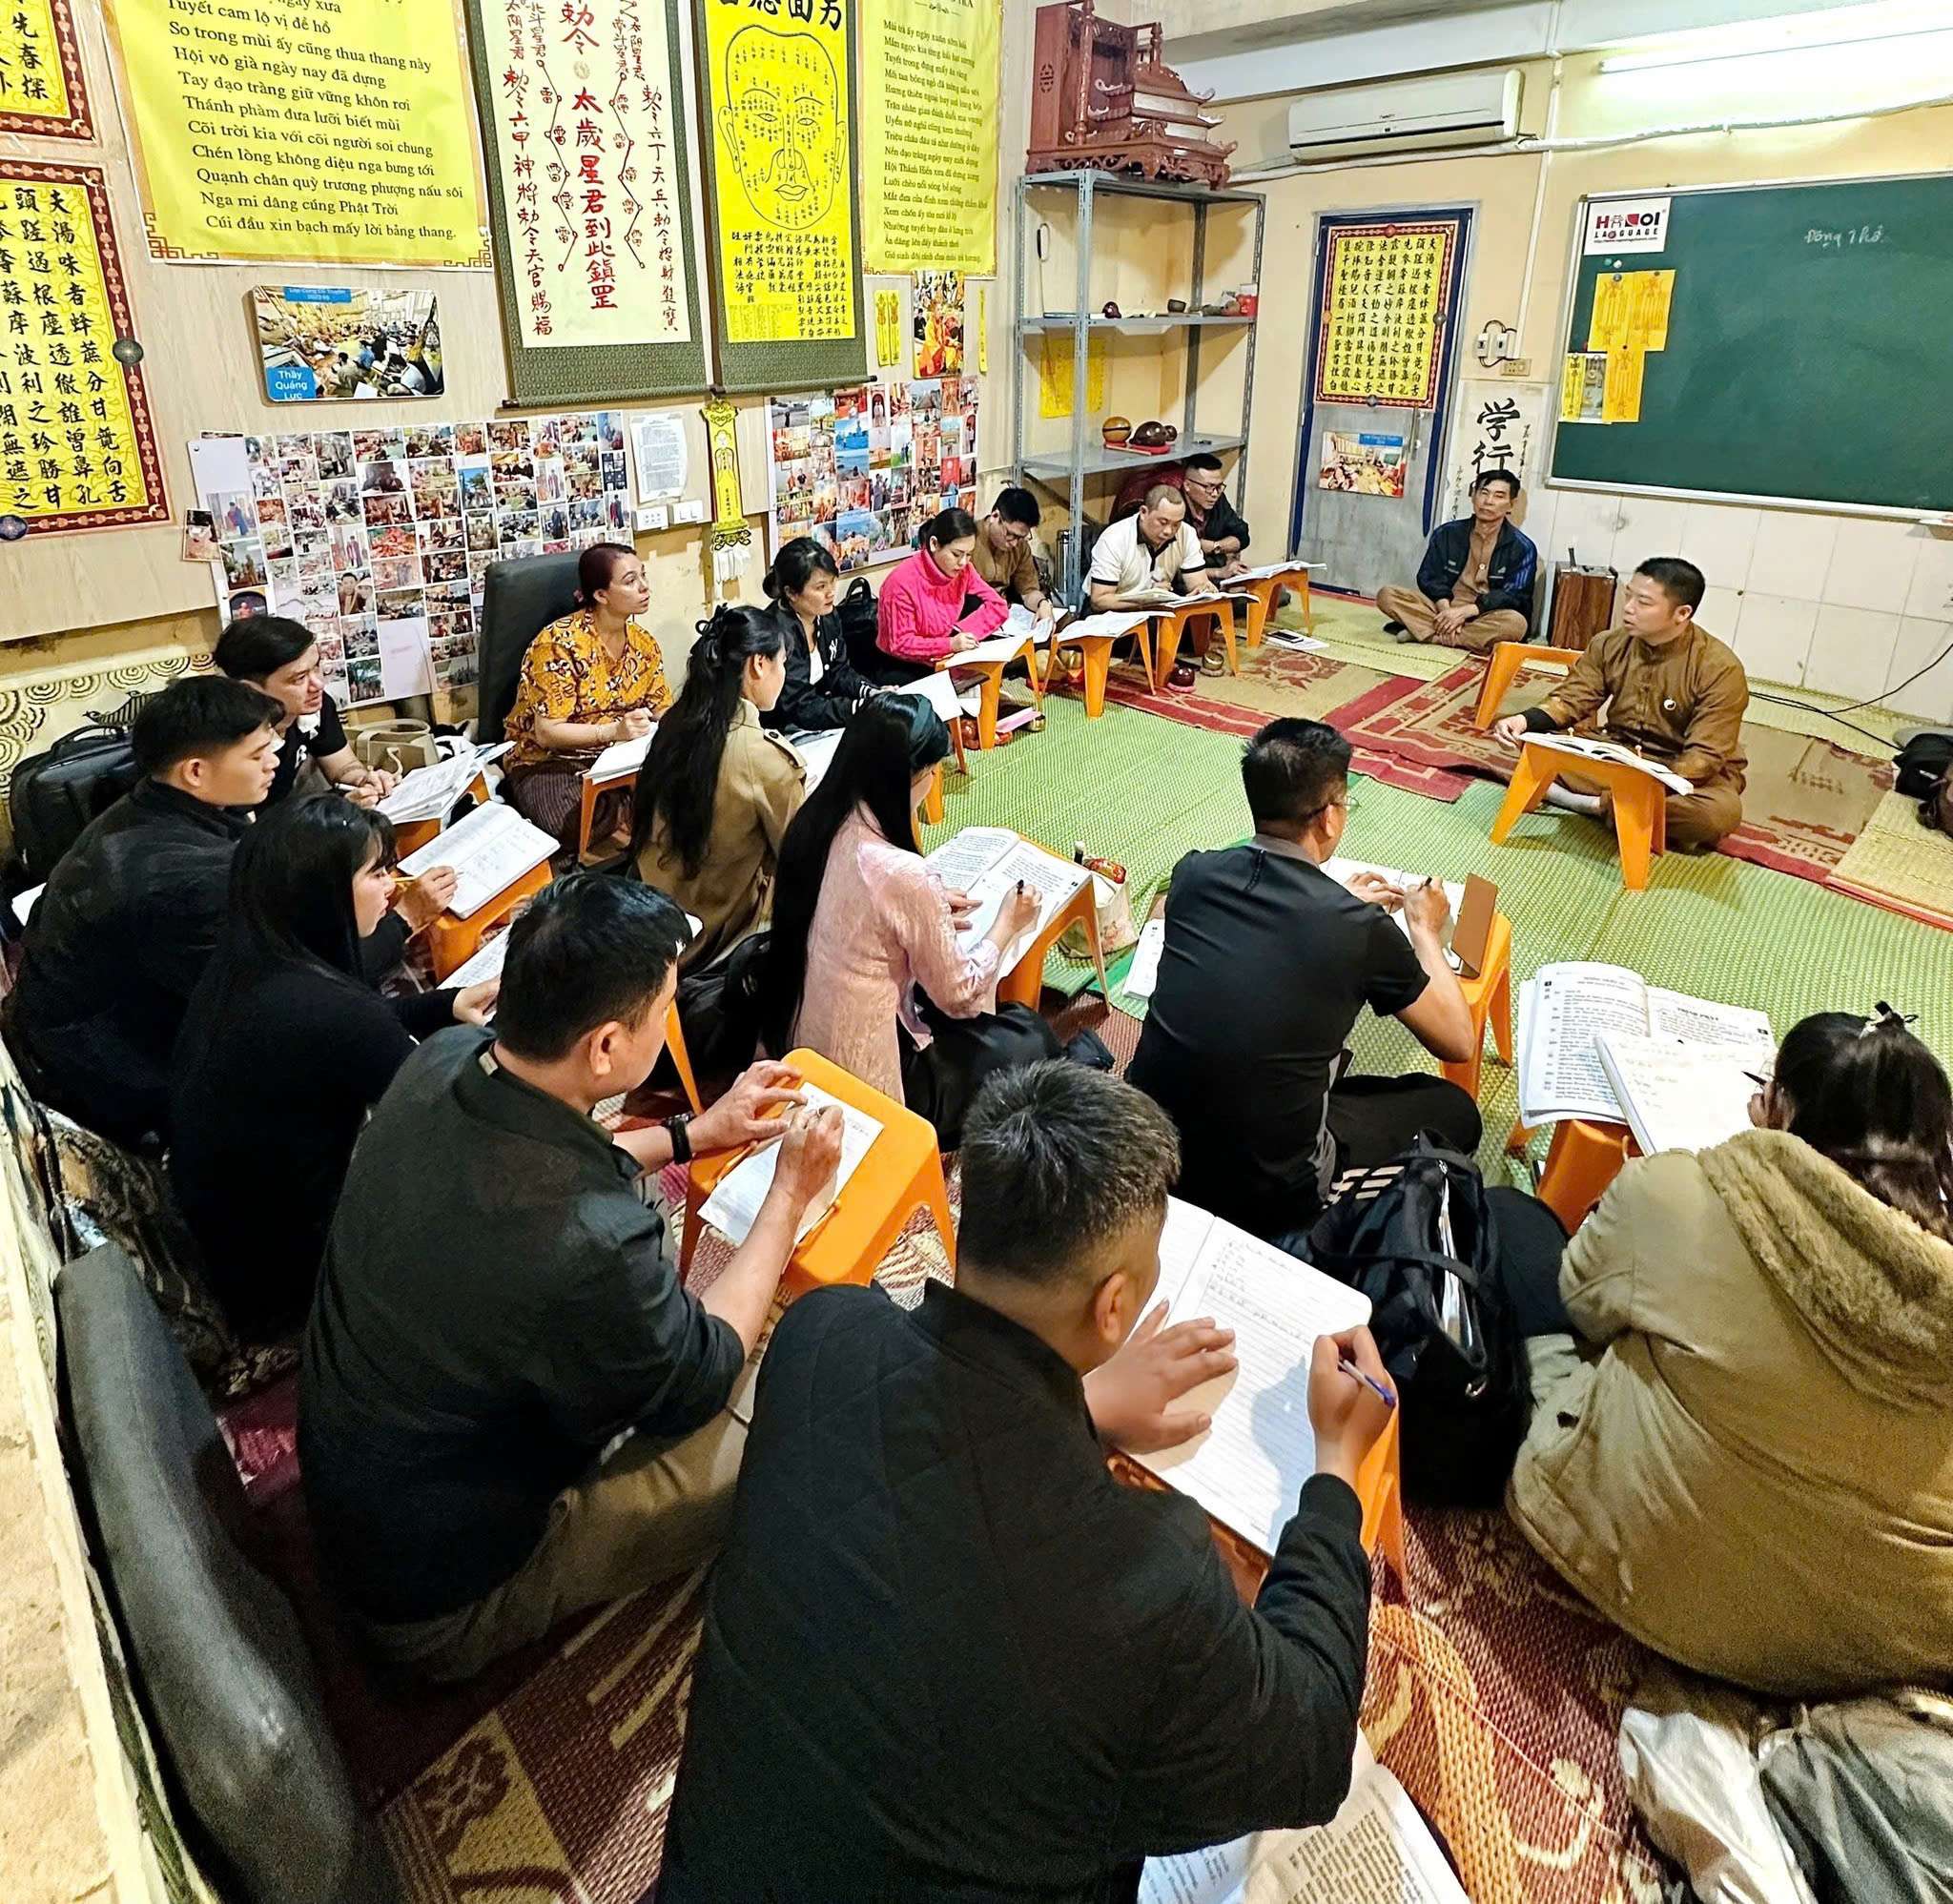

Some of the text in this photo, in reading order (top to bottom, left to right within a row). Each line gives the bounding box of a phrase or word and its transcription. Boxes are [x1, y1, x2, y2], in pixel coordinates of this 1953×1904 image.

[218, 6, 250, 21] cam
[256, 10, 270, 27] lộ
[275, 14, 288, 31] vị
[169, 21, 431, 73] So trong mùi ấy cũng thua thang này
[173, 46, 386, 89] Hội vô già ngày nay đã dựng
[177, 71, 209, 90] Tay
[214, 76, 242, 93] đạo
[248, 81, 287, 100] tràng
[356, 93, 389, 109] khôn
[182, 95, 235, 113] Thánh
[238, 103, 280, 118] phàm
[284, 108, 310, 122] đưa
[346, 113, 372, 129] biết
[376, 118, 401, 132] mùi
[188, 120, 433, 157] Cõi trời kia với cõi người soi chung
[193, 144, 435, 176] Chén lòng không diệu nga bưng tới
[196, 168, 249, 185] Quạnh
[254, 173, 289, 187] chân
[371, 182, 416, 198] phượng
[419, 186, 442, 196] nấu
[445, 186, 463, 198] sôi
[200, 191, 399, 216] Nga mi dâng cúng Phật Trời
[206, 215, 233, 229] Cúi
[269, 218, 292, 232] xin
[296, 219, 328, 235] bạch
[333, 221, 360, 237] mấy
[365, 223, 382, 235] lời
[1594, 228, 1658, 239] LAGUAGE
